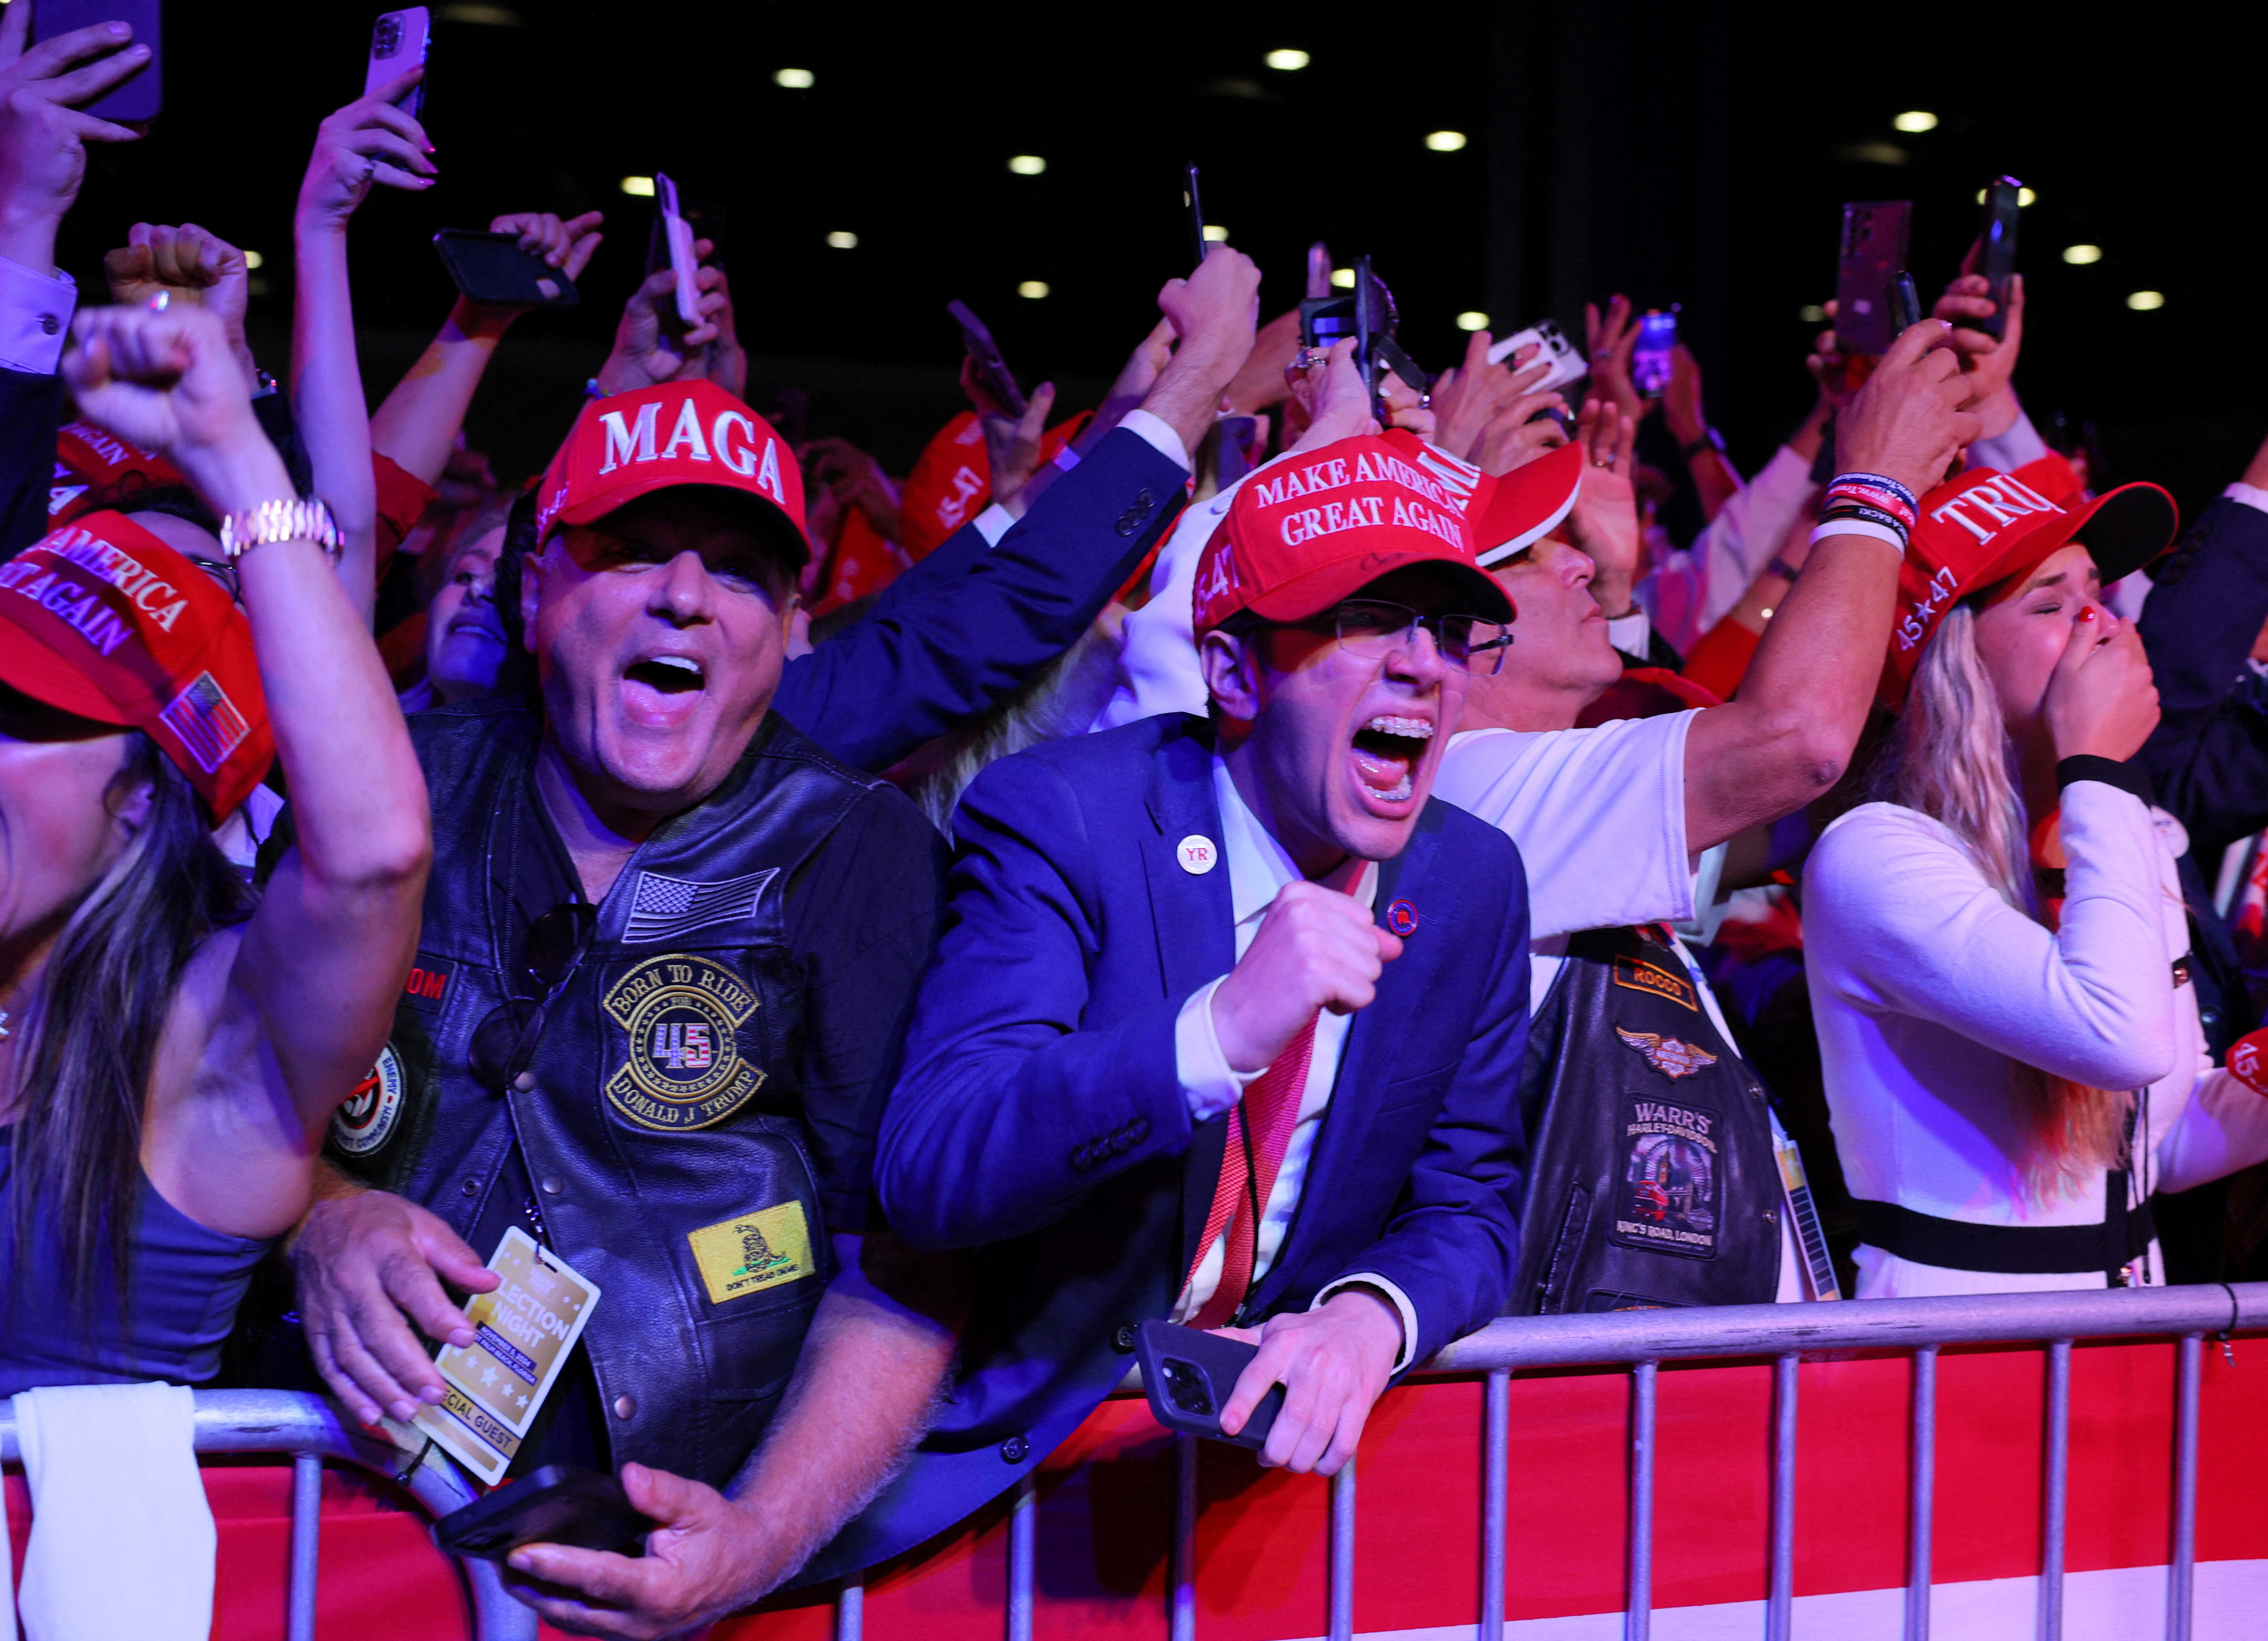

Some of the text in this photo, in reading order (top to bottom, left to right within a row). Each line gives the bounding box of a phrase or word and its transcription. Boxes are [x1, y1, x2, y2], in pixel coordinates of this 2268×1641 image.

[599, 398, 786, 505] MAGA
[1254, 452, 1465, 520] MAKE AMERICA
[1281, 496, 1465, 553] GREAT AGAIN
[1929, 474, 2068, 546] TRU
[40, 526, 189, 633] AMERICA
[15, 572, 136, 656] AGAIN
[1185, 847, 1209, 863] YR
[612, 964, 752, 1015] BORN TO RIDE
[669, 997, 692, 1006] FOR
[1633, 968, 1682, 997] ROCCO
[653, 1023, 712, 1069] 45
[382, 1056, 398, 1094] ENEMY
[613, 1070, 755, 1124] DONALD J TRUMP
[1634, 1102, 1713, 1134] WARR'S
[1675, 1230, 1712, 1247] LONDON
[480, 1325, 512, 1352] NOVEMBER
[491, 1300, 546, 1348] NIGHT
[474, 1414, 513, 1449] GUEST
